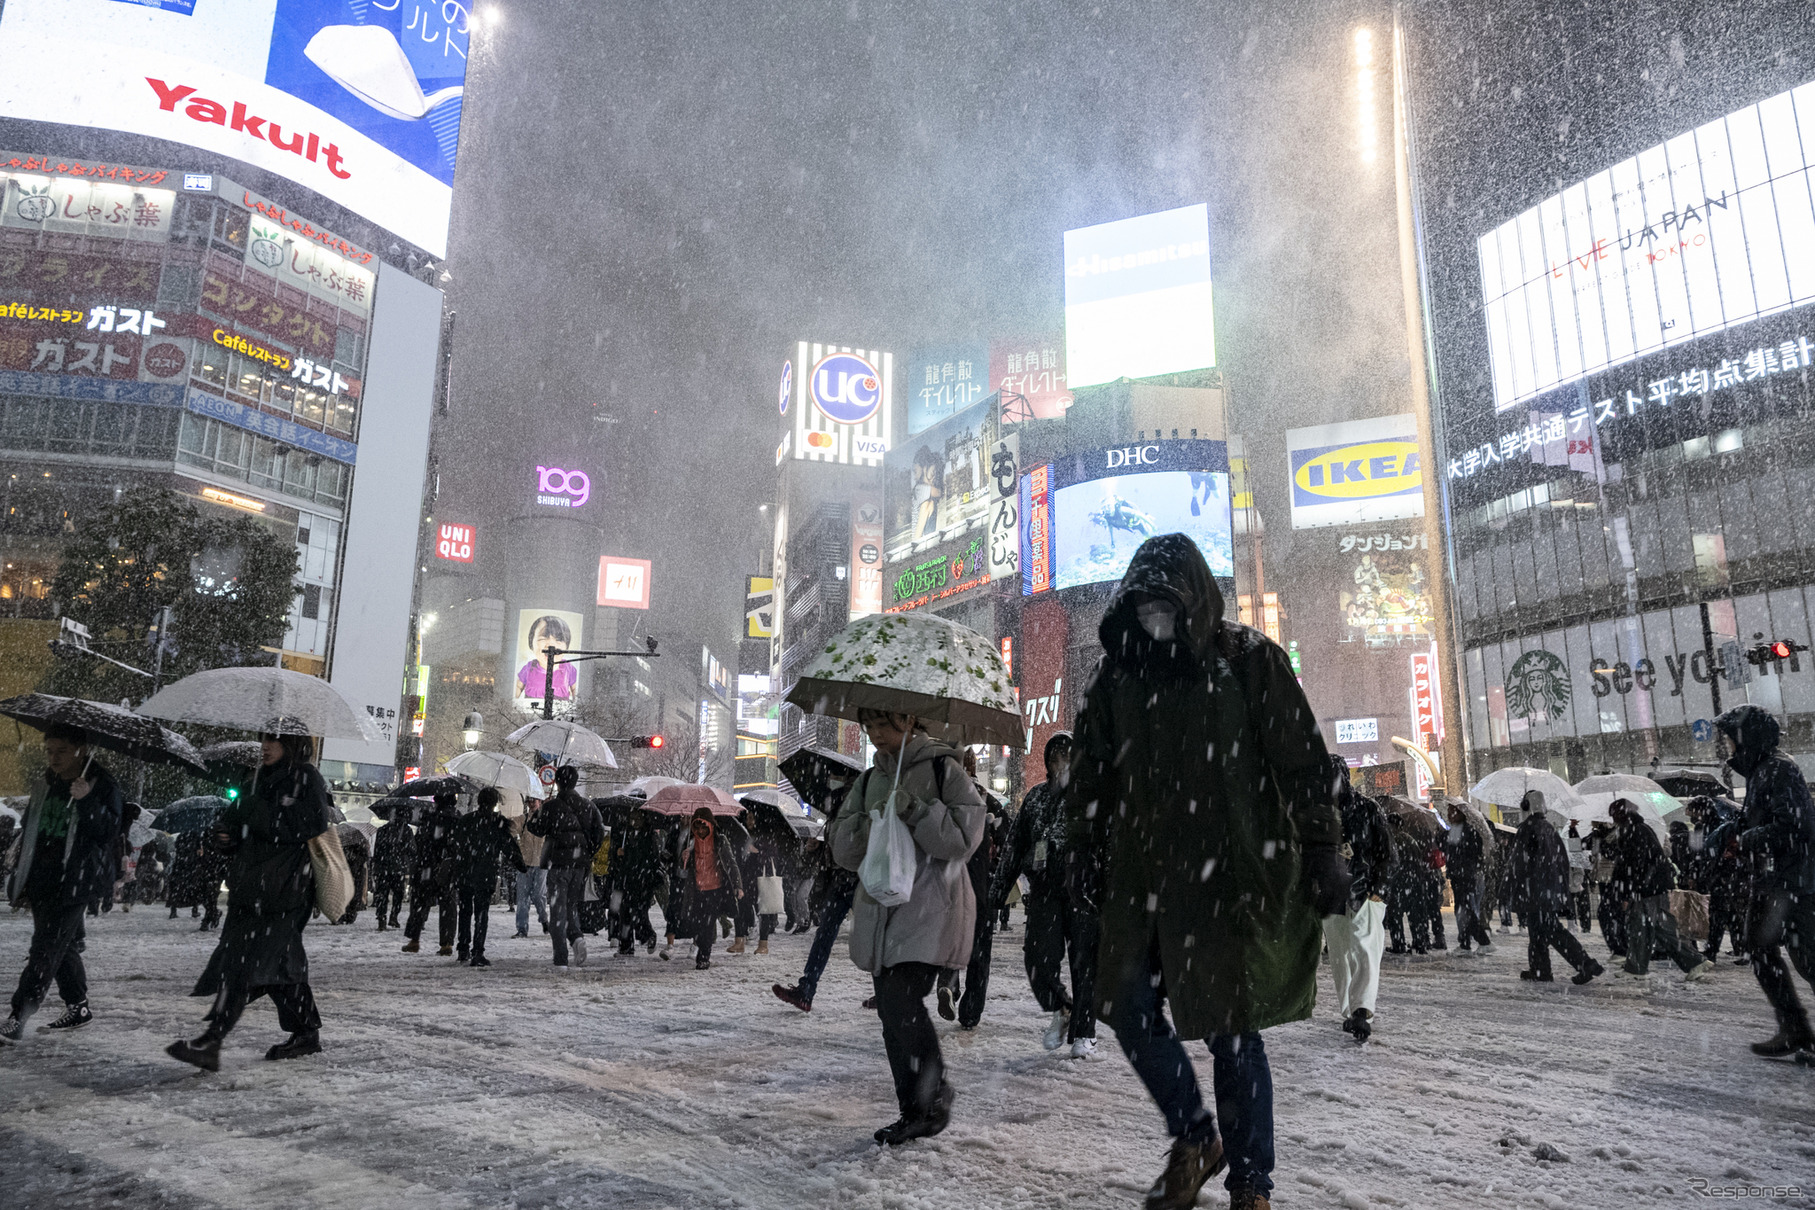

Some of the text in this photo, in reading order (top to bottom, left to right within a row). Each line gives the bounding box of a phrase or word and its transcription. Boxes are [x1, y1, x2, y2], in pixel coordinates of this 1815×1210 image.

[145, 77, 351, 179] Yakult
[63, 193, 162, 228] しゃぶ葉
[244, 191, 373, 265] しゃぶしゃぶバイキング
[1620, 190, 1728, 251] JAPAN
[1645, 234, 1706, 265] TOKYO
[291, 248, 365, 302] しゃぶ葉
[87, 305, 166, 335] ガスト
[202, 277, 330, 346] コンタクト
[31, 338, 131, 375] ガスト
[926, 360, 973, 385] 龍角散
[1008, 347, 1057, 374] 龍角散
[291, 358, 349, 395] ガスト
[1000, 371, 1067, 397] ダイレクト
[919, 382, 982, 407] ダイレクト
[1447, 336, 1815, 479] 大学入学共通テスト平均点集計
[246, 411, 354, 457] 英会話イーオン
[856, 440, 886, 454] VISA
[1106, 446, 1160, 468] DHC
[1308, 452, 1422, 488] IKEA
[536, 465, 591, 507] 109
[537, 495, 570, 507] SHIBUYA
[991, 442, 1018, 573] もんじゃ
[440, 540, 471, 559] QLO
[441, 524, 470, 543] UNI
[1415, 663, 1433, 726] カラオケ
[1590, 657, 1656, 698] See
[376, 722, 392, 731] クト
[1339, 732, 1377, 741] クリニック
